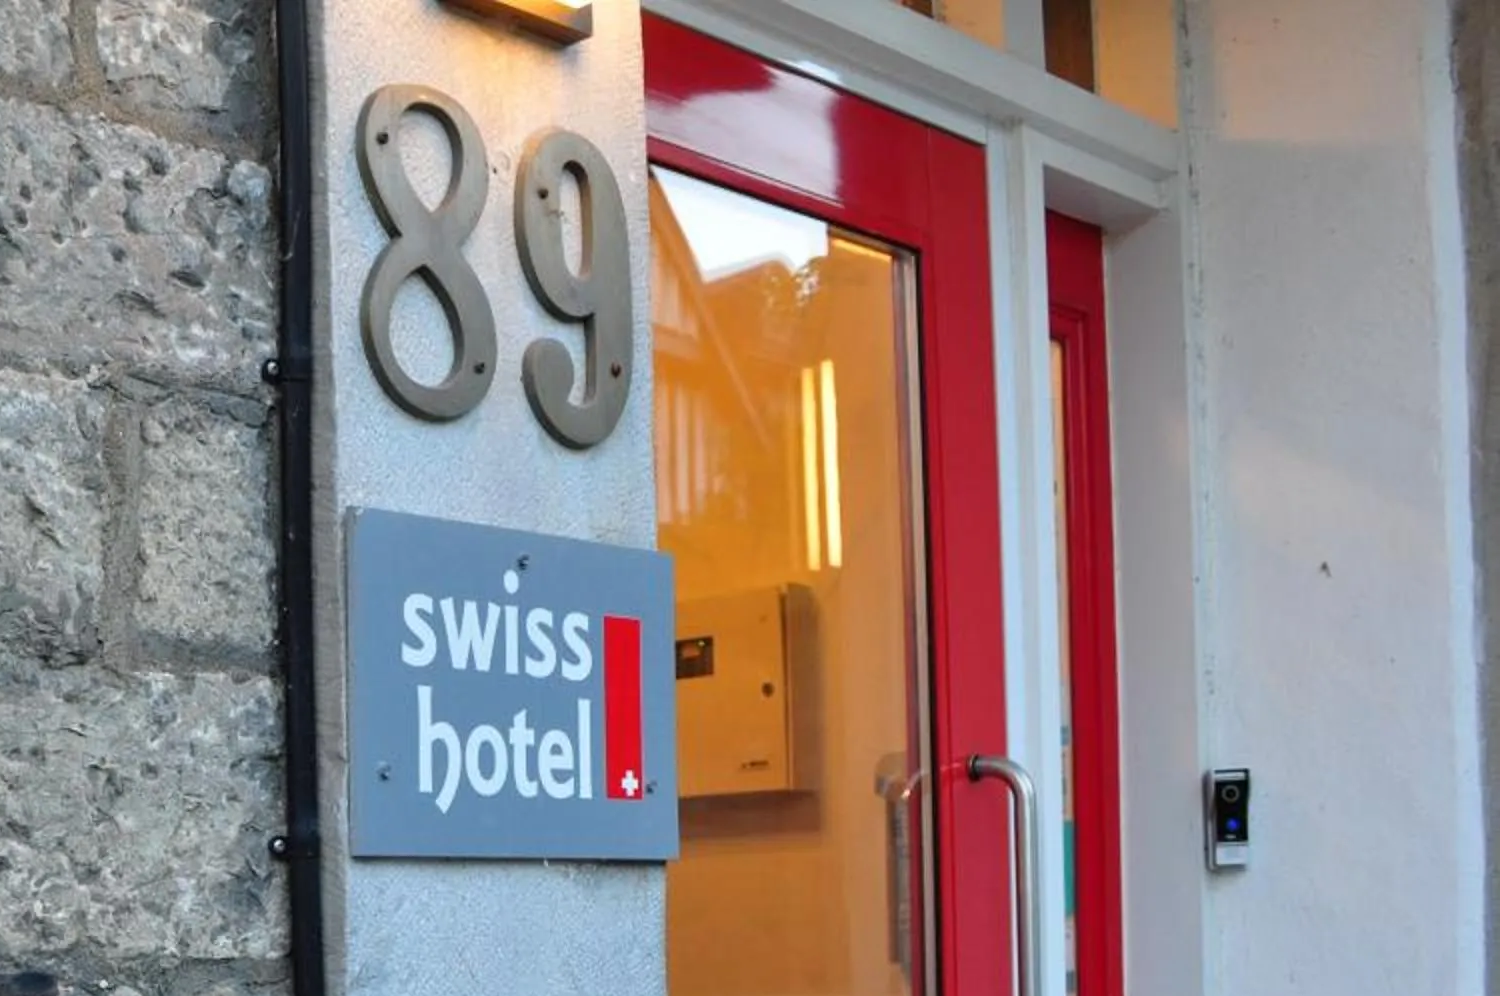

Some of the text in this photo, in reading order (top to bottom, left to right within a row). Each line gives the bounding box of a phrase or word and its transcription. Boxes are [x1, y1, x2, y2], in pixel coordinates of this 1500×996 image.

[355, 83, 633, 449] 89
[401, 570, 593, 681] swiss
[417, 685, 593, 814] hotel
